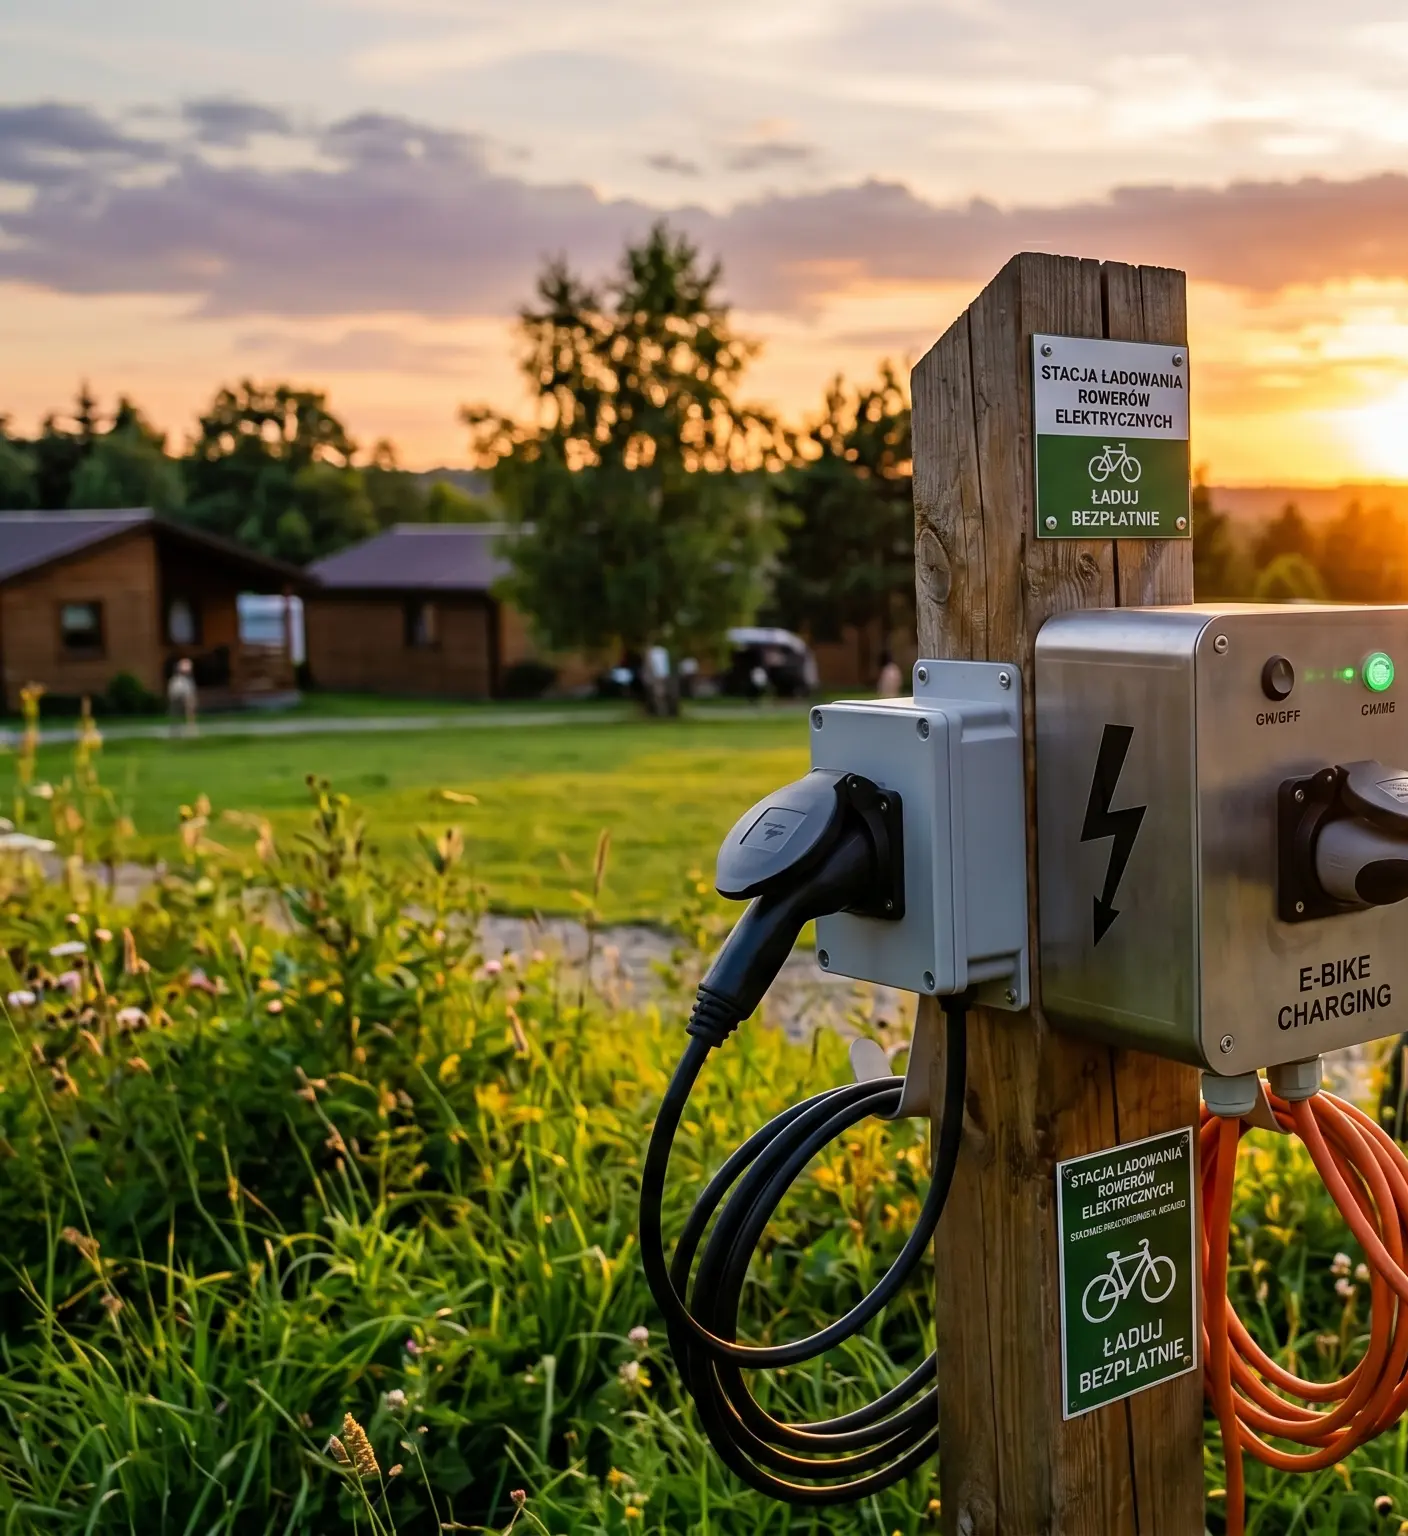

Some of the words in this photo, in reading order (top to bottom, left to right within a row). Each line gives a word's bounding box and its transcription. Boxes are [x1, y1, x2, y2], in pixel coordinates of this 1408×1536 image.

[1041, 365, 1098, 383] STACJA
[1101, 369, 1183, 389] ŁADOWANIA
[1078, 389, 1150, 407] ROWERÓW
[1055, 408, 1173, 429] ELEKTRYCZNYCH
[1091, 489, 1139, 505] ŁADUJ
[1071, 511, 1160, 526] BEZPŁATNIE
[1299, 954, 1371, 993] E-BIKE
[1277, 983, 1392, 1031] CHARGING
[1070, 1165, 1115, 1189] STACJA
[1098, 1170, 1155, 1198] ROWERÓW
[1082, 1181, 1174, 1220] ELEKTRYCZNYCH
[1103, 1318, 1163, 1358] ŁADUJ
